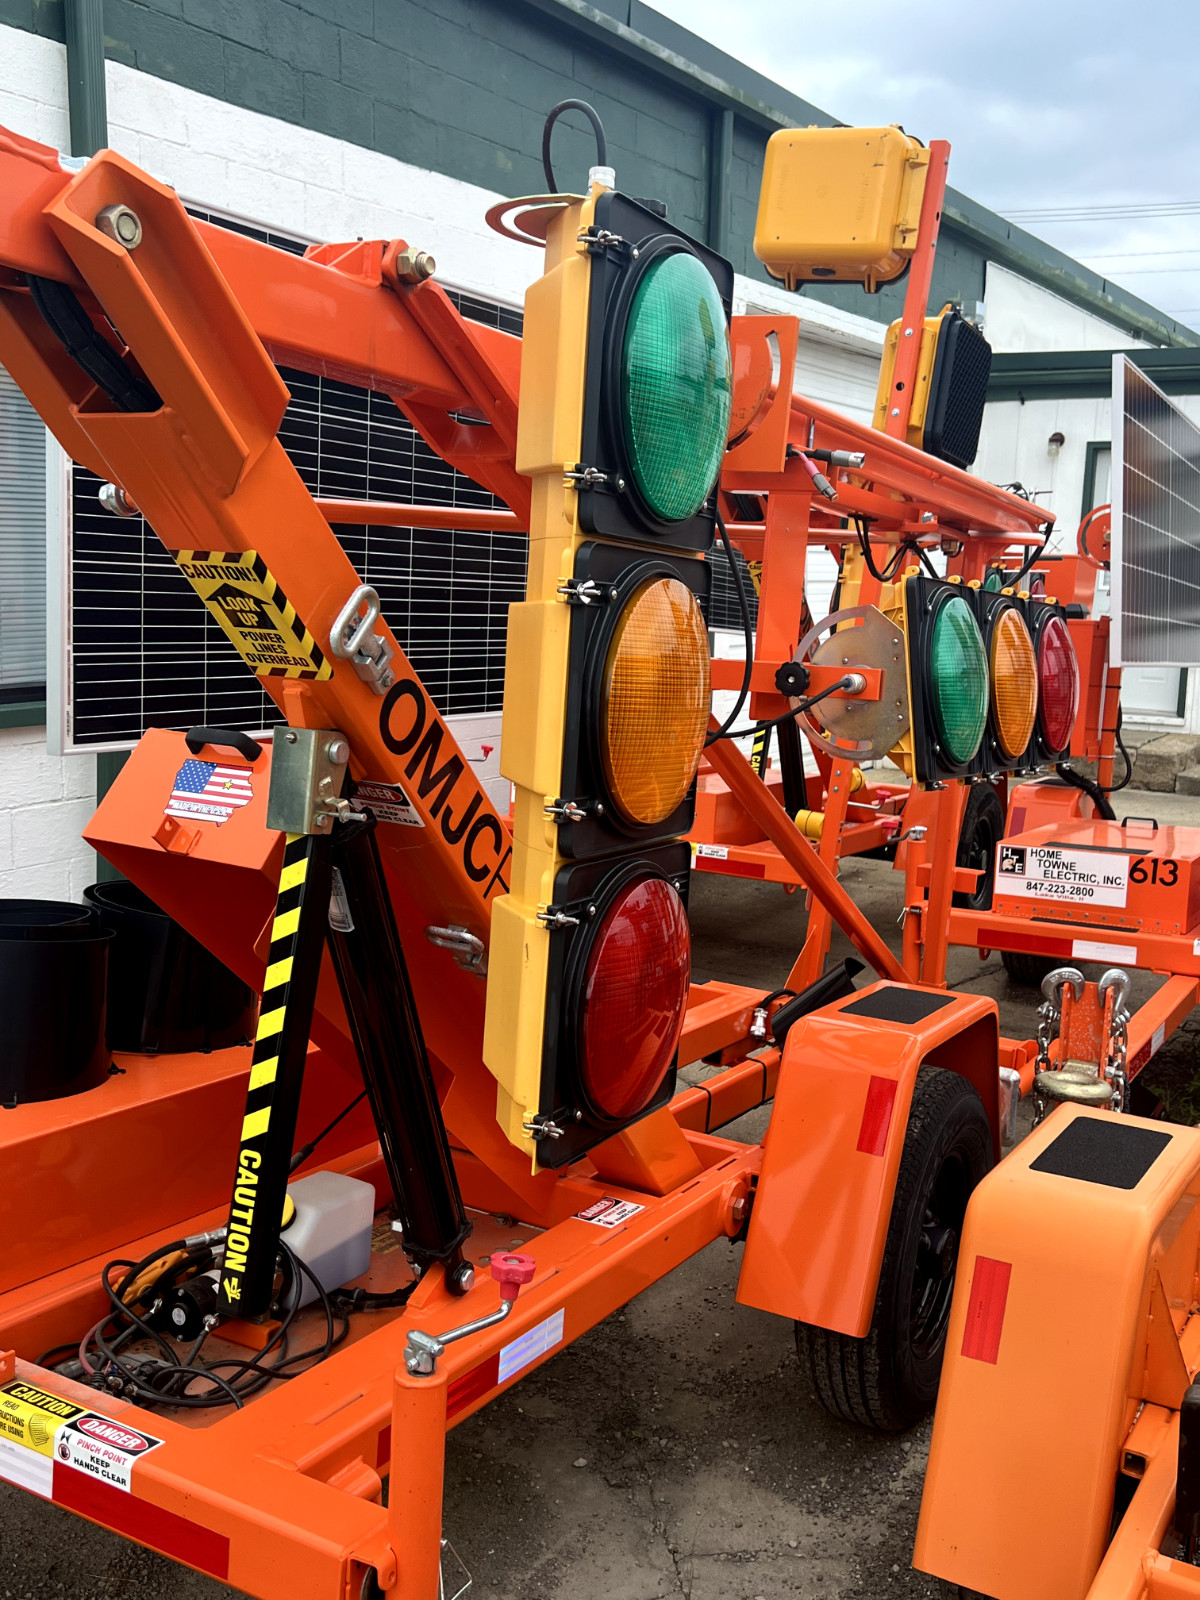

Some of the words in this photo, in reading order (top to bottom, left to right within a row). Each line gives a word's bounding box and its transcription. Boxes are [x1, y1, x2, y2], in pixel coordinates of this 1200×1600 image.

[180, 563, 258, 582] CAUTION!
[217, 596, 261, 612] LOOK
[237, 613, 259, 626] UP
[239, 631, 286, 644] POWER
[251, 642, 288, 655] LINES
[245, 652, 310, 668] OVERHEAD
[358, 786, 396, 800] NGER
[1030, 848, 1062, 860] HOME
[1037, 859, 1077, 871] TOWNE
[1129, 858, 1178, 887] 613
[1043, 870, 1100, 885] ELECTRIC,
[1103, 876, 1125, 887] INC.
[1026, 881, 1094, 897] 847-223-2800
[224, 1149, 262, 1273] CAUTION
[2, 1400, 19, 1411] READ
[10, 1386, 77, 1417] CAUTION
[8, 1425, 24, 1438] USING
[83, 1420, 142, 1450] DANGER
[77, 1438, 102, 1455] PINCH
[102, 1449, 128, 1466] POINT
[90, 1455, 111, 1469] KEEP
[73, 1456, 100, 1474] HANDS
[101, 1469, 127, 1487] CLEAR
